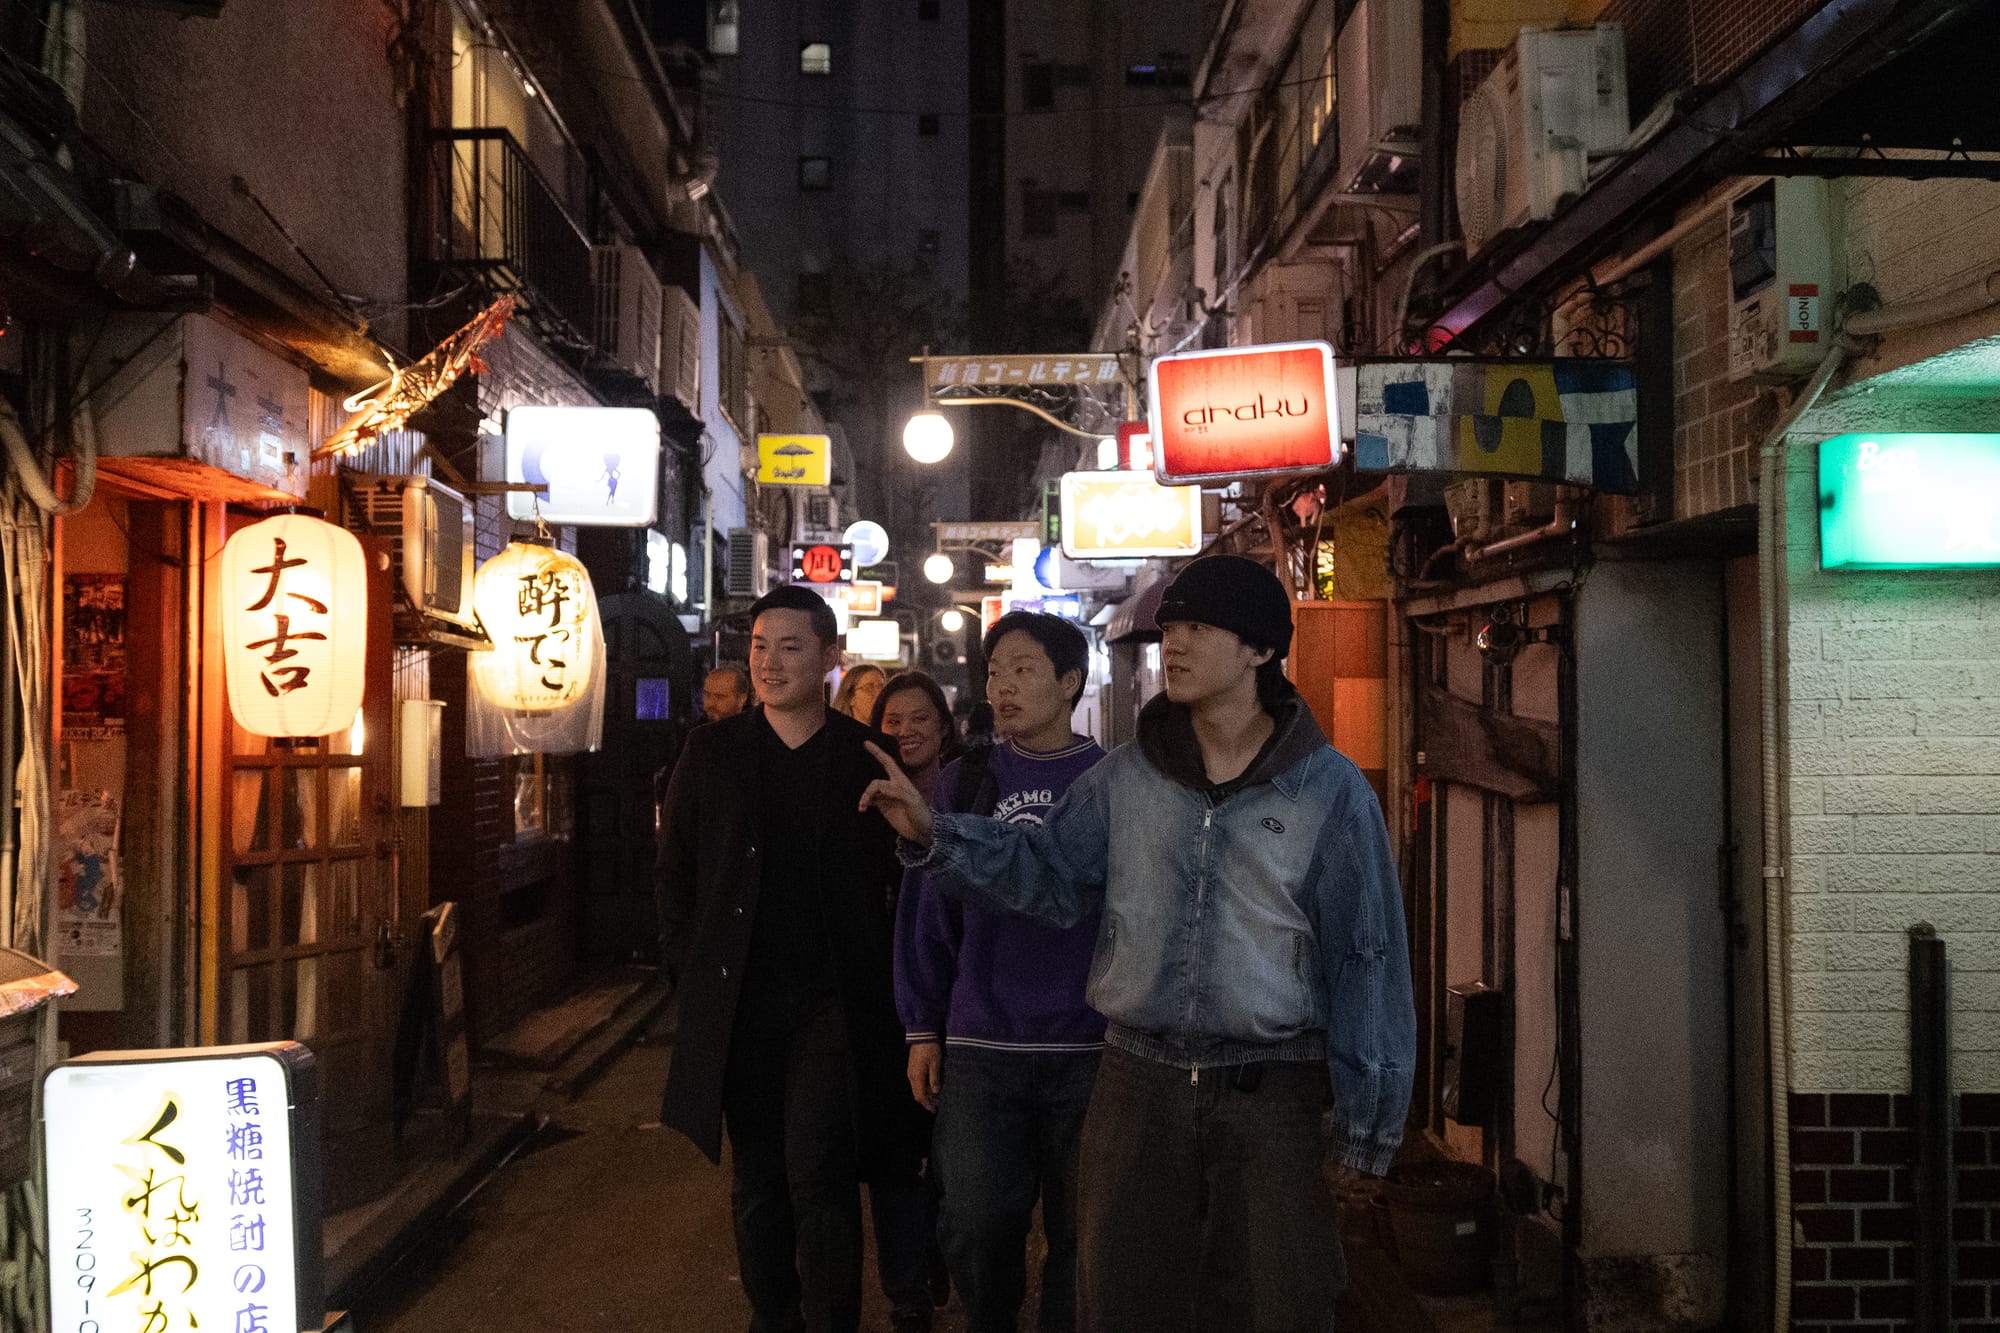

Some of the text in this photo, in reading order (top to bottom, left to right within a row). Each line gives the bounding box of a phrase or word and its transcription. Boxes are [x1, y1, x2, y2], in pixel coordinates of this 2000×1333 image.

[1798, 297, 1810, 330] INOP
[1183, 391, 1309, 426] araku
[245, 537, 328, 698] 大吉
[513, 570, 571, 691] 酔ってこ
[225, 1077, 269, 1333] 黒糖焼酎の店
